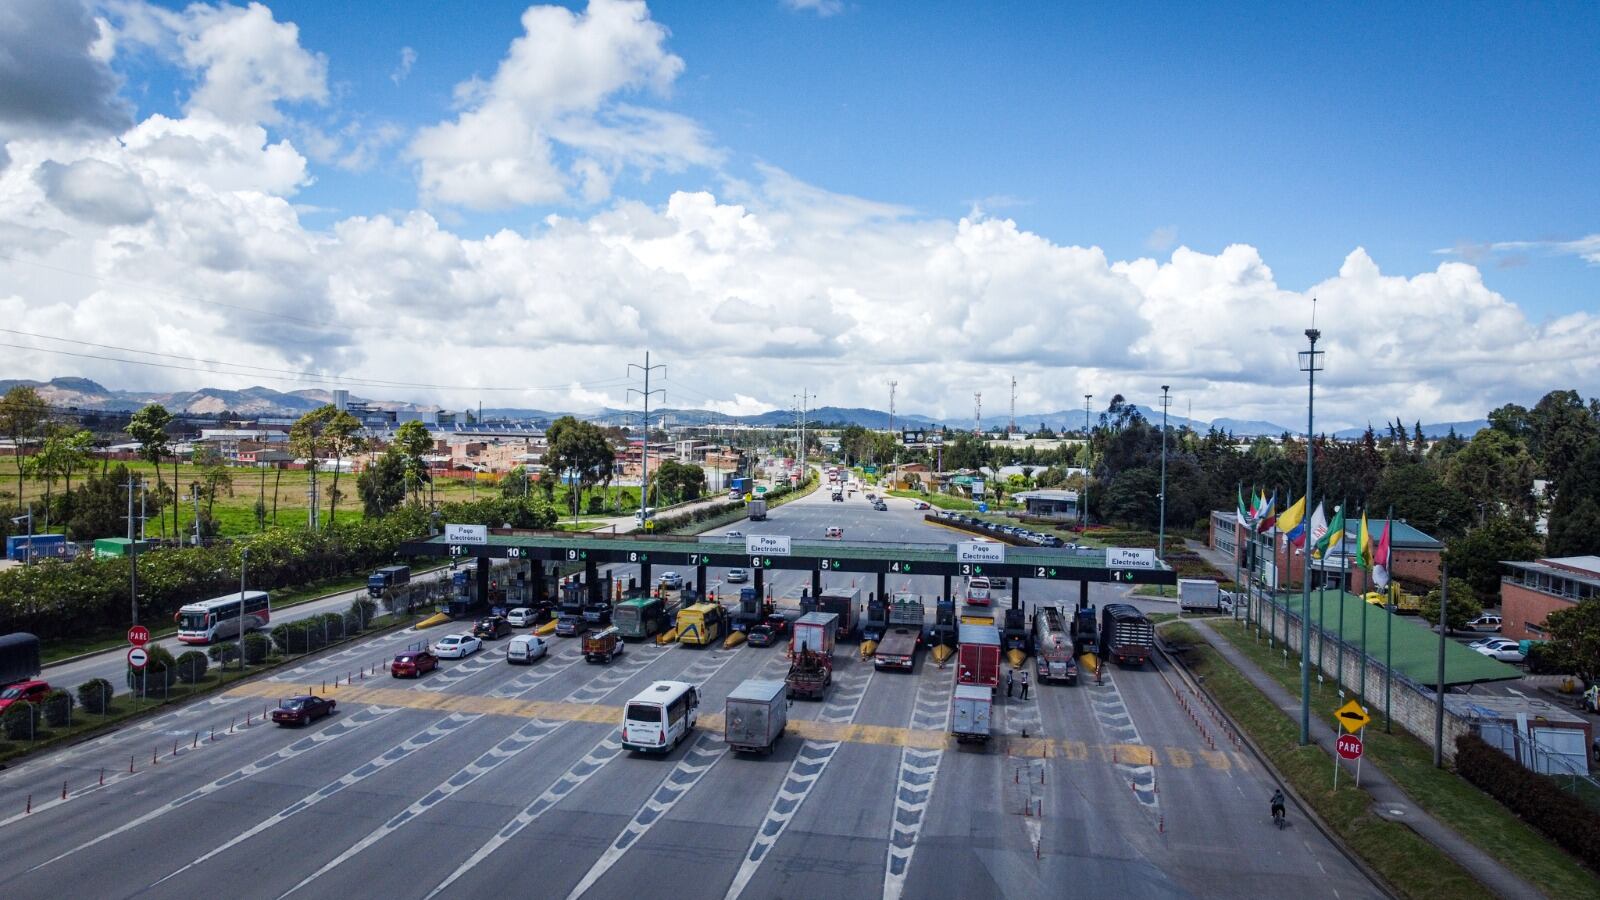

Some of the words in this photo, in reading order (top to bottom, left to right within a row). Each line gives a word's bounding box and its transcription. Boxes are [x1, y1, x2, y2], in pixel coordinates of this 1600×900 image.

[760, 537, 776, 545] Pago
[450, 545, 461, 555] 11
[507, 548, 519, 557] 10
[569, 550, 576, 559] 9
[630, 552, 637, 562] 8
[691, 555, 698, 564] 7
[1122, 551, 1139, 559] Pago
[752, 557, 760, 567] 6
[821, 559, 828, 569] 5
[892, 562, 899, 571] 4
[962, 565, 970, 574] 3
[1038, 567, 1045, 577] 2
[1113, 571, 1121, 581] 1
[130, 632, 147, 640] PARE
[1339, 741, 1360, 754] PARE
